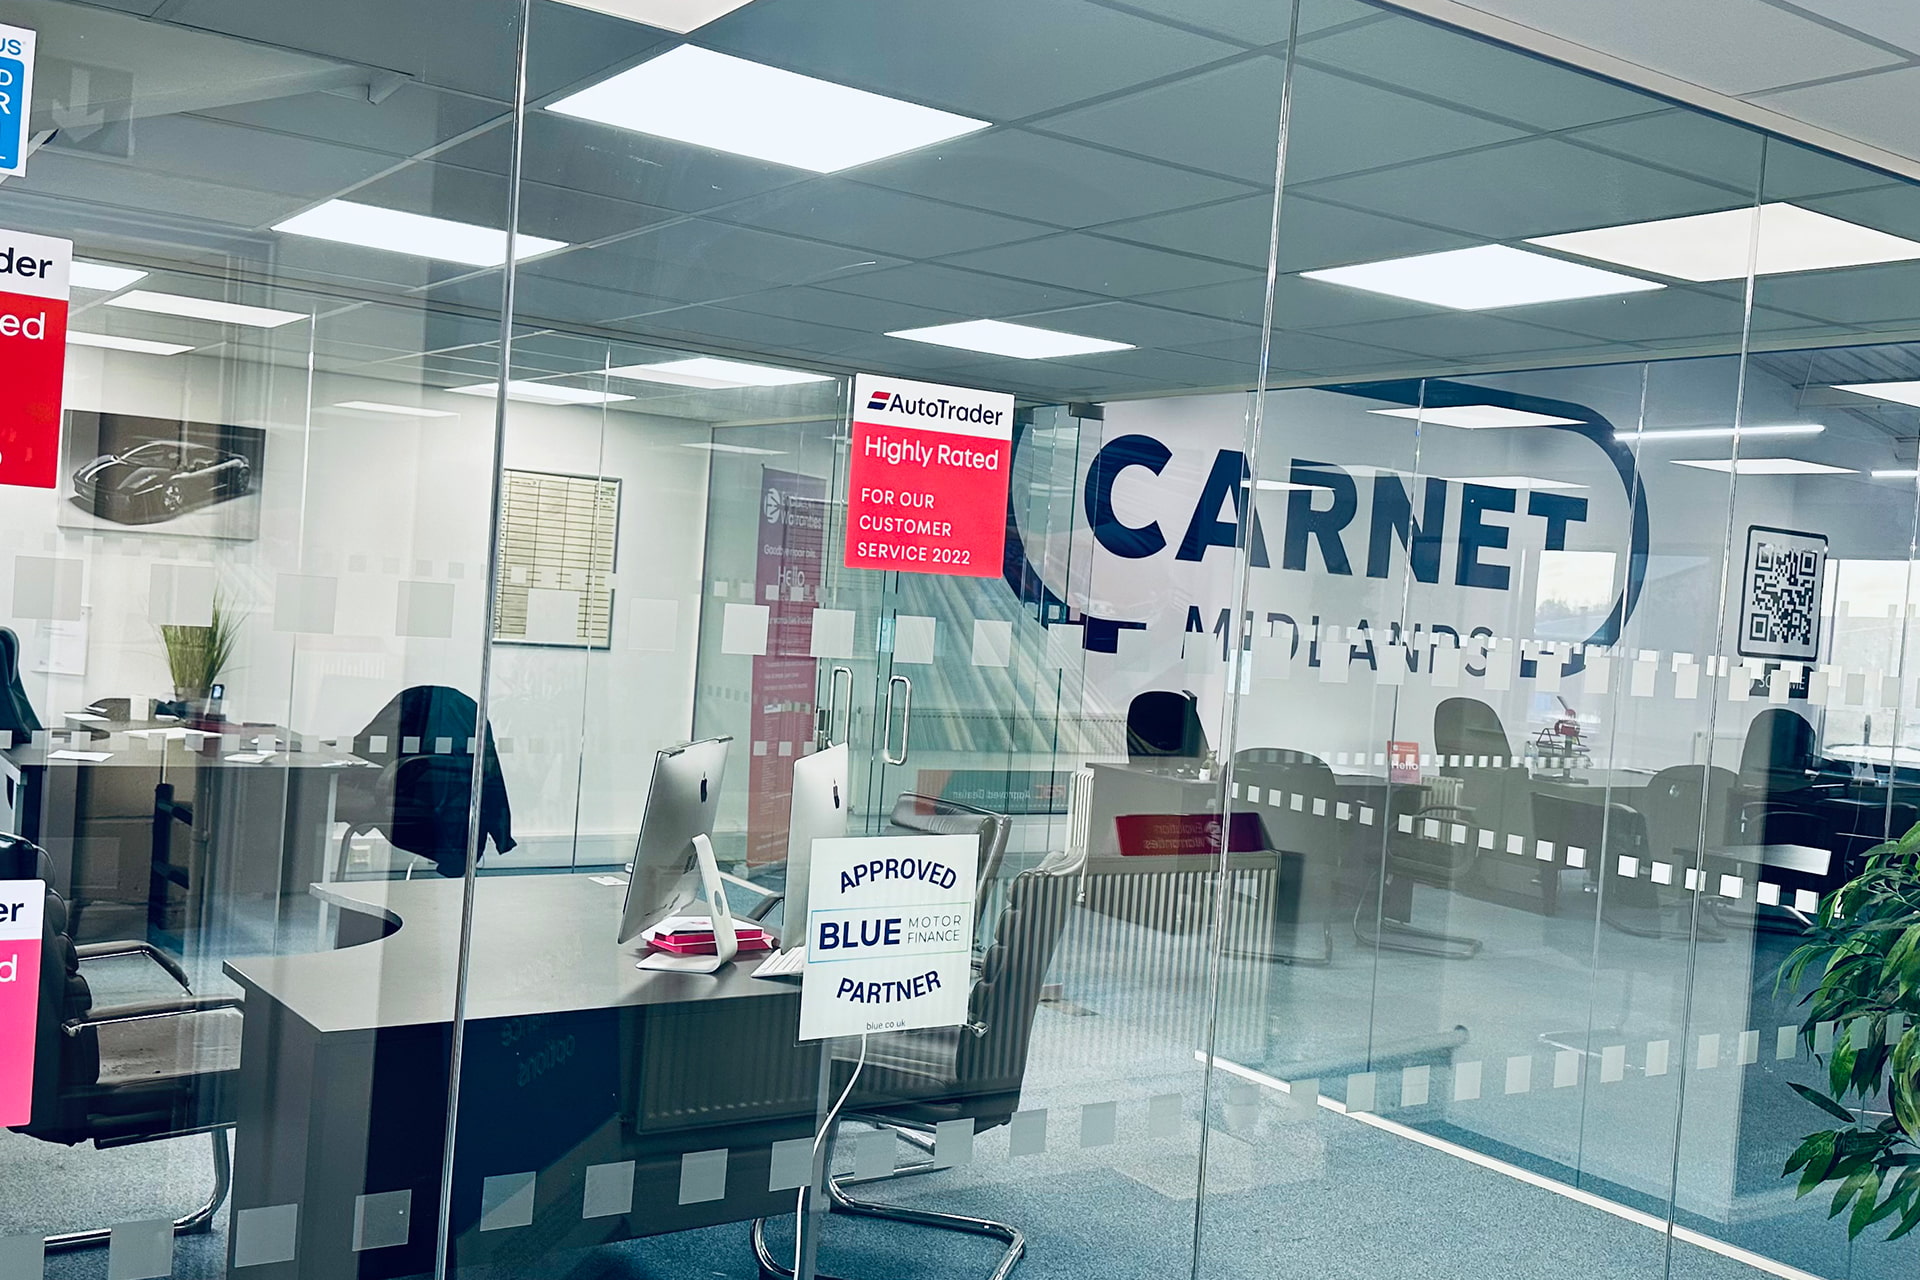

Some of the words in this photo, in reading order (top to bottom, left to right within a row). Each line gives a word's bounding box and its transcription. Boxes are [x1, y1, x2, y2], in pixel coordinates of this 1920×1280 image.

[0, 311, 46, 340] ed
[889, 393, 1003, 426] AutoTrader
[864, 435, 934, 467] Highly
[937, 444, 999, 470] Rated
[861, 487, 894, 505] FOR
[900, 491, 935, 508] OUR
[859, 515, 952, 537] CUSTOMER
[1084, 434, 1589, 591] CARNET
[857, 541, 928, 562] SERVICE
[932, 548, 971, 565] 2022
[777, 565, 805, 587] Hello
[840, 858, 957, 894] APPROVED
[819, 918, 902, 950] BLUE
[908, 914, 962, 929] MOTOR
[907, 929, 960, 944] FINANCE
[836, 970, 942, 1004] PARTNER
